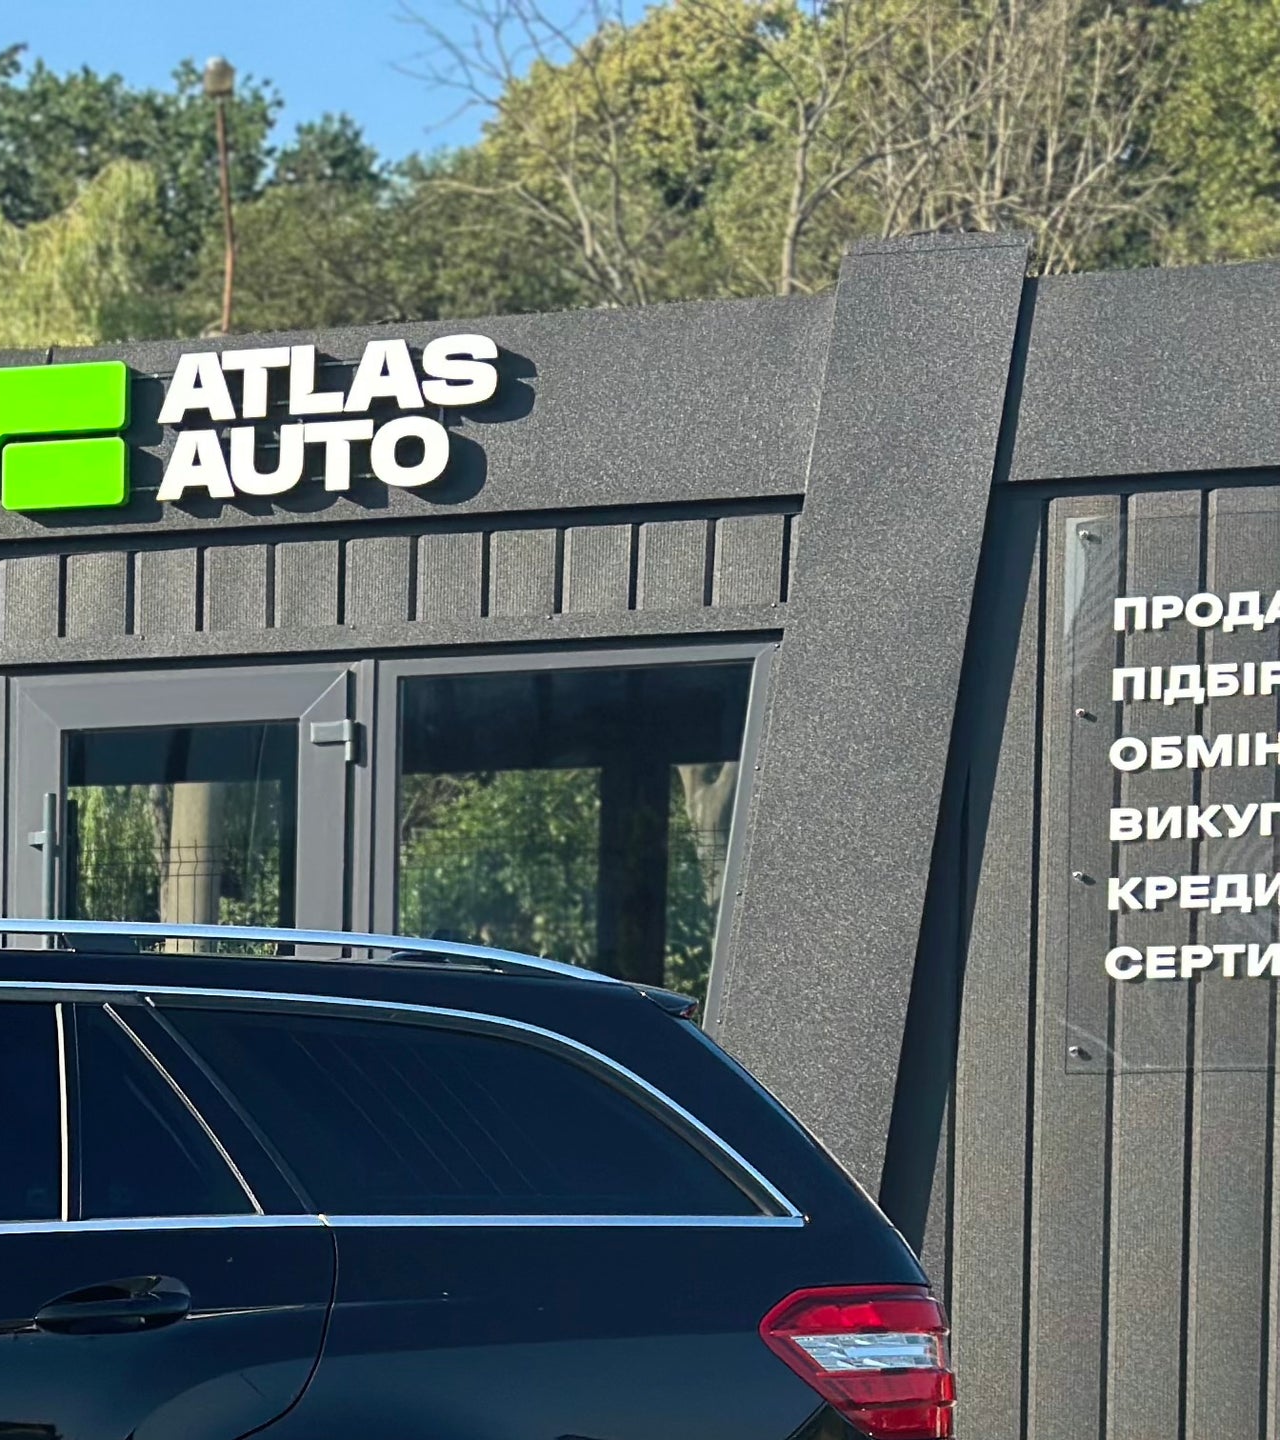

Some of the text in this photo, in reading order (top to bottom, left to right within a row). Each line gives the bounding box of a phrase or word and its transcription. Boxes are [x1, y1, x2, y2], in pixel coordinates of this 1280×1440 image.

[158, 334, 498, 425] ATLAS
[156, 416, 450, 501] AUTO
[1109, 732, 1280, 771] ОБМІН
[1107, 872, 1280, 914] КРЕДИ
[1104, 943, 1280, 980] СЕРТИ
